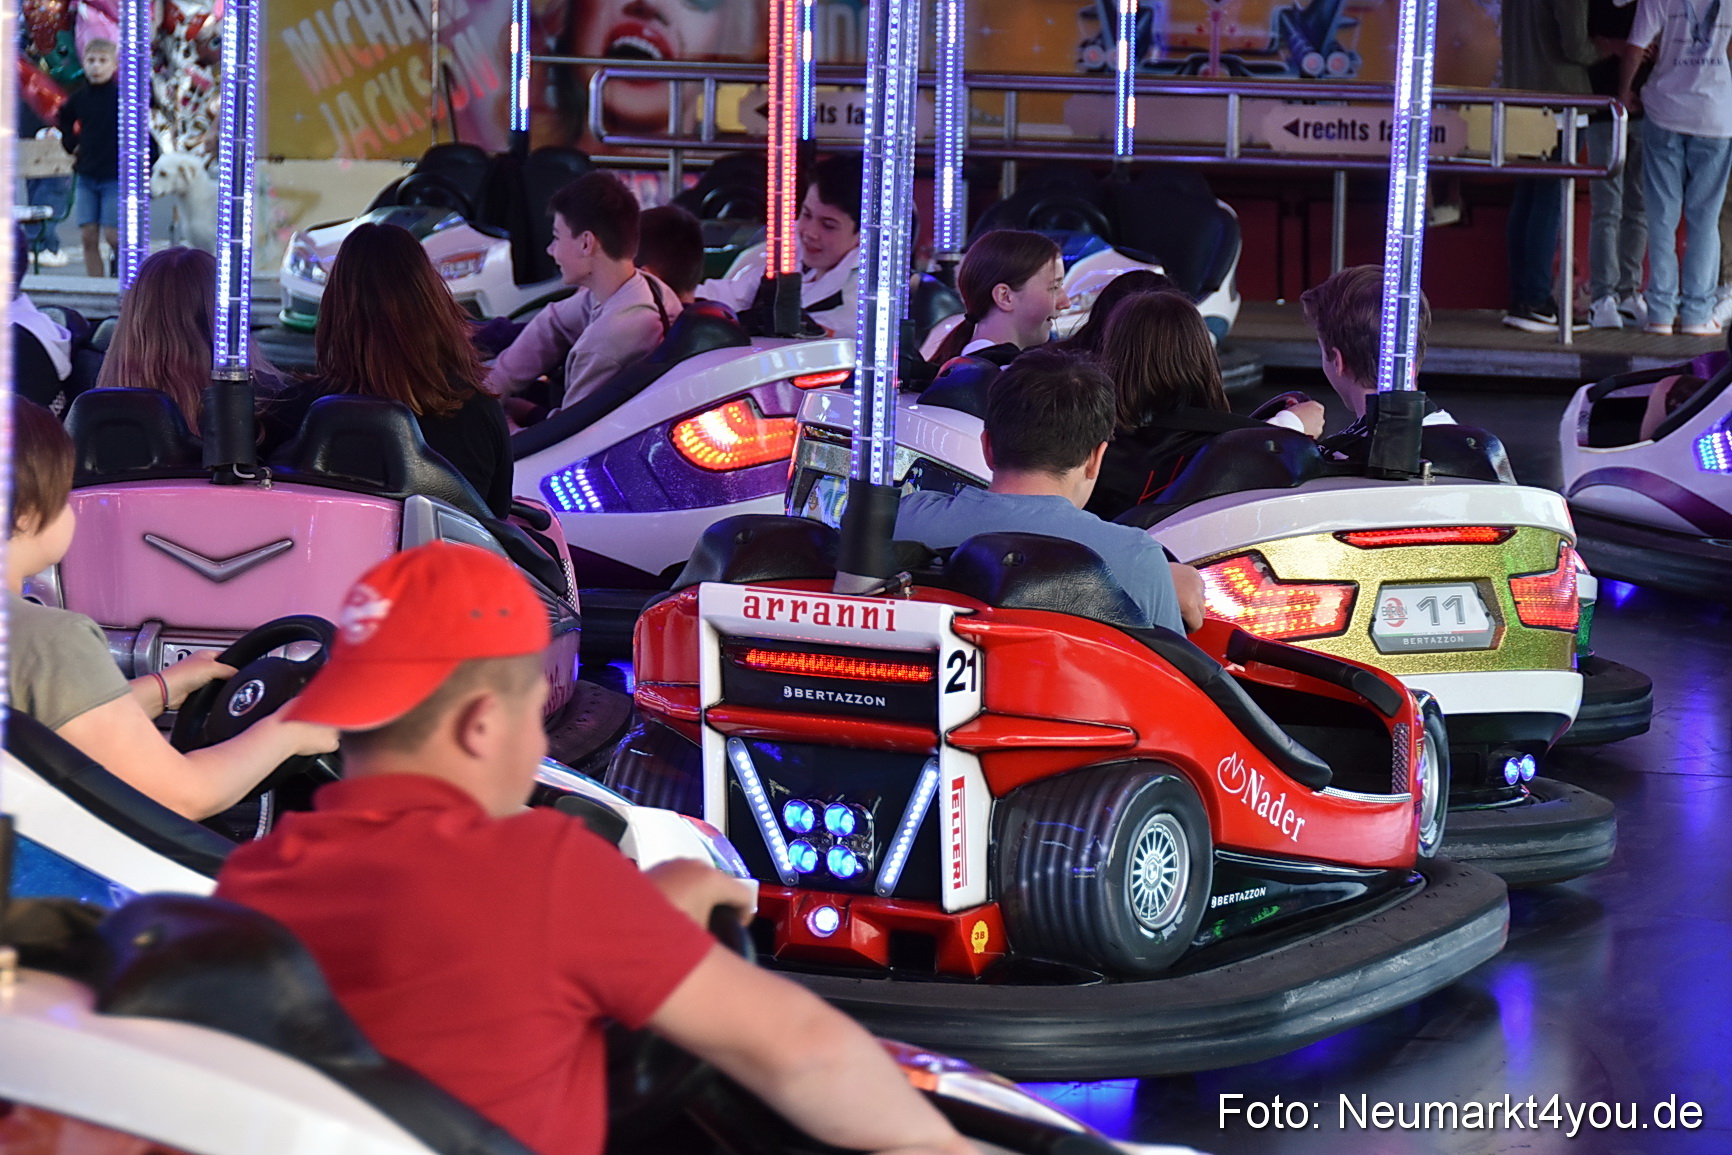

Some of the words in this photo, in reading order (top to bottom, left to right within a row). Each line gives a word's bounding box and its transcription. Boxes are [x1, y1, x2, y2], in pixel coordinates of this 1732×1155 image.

[1302, 117, 1370, 141] rechts
[743, 594, 896, 632] arranni
[1416, 594, 1466, 626] 11
[1402, 635, 1465, 645] BERTAZZON
[944, 648, 977, 695] 21
[1240, 767, 1306, 843] Nader
[974, 930, 985, 941] 3B
